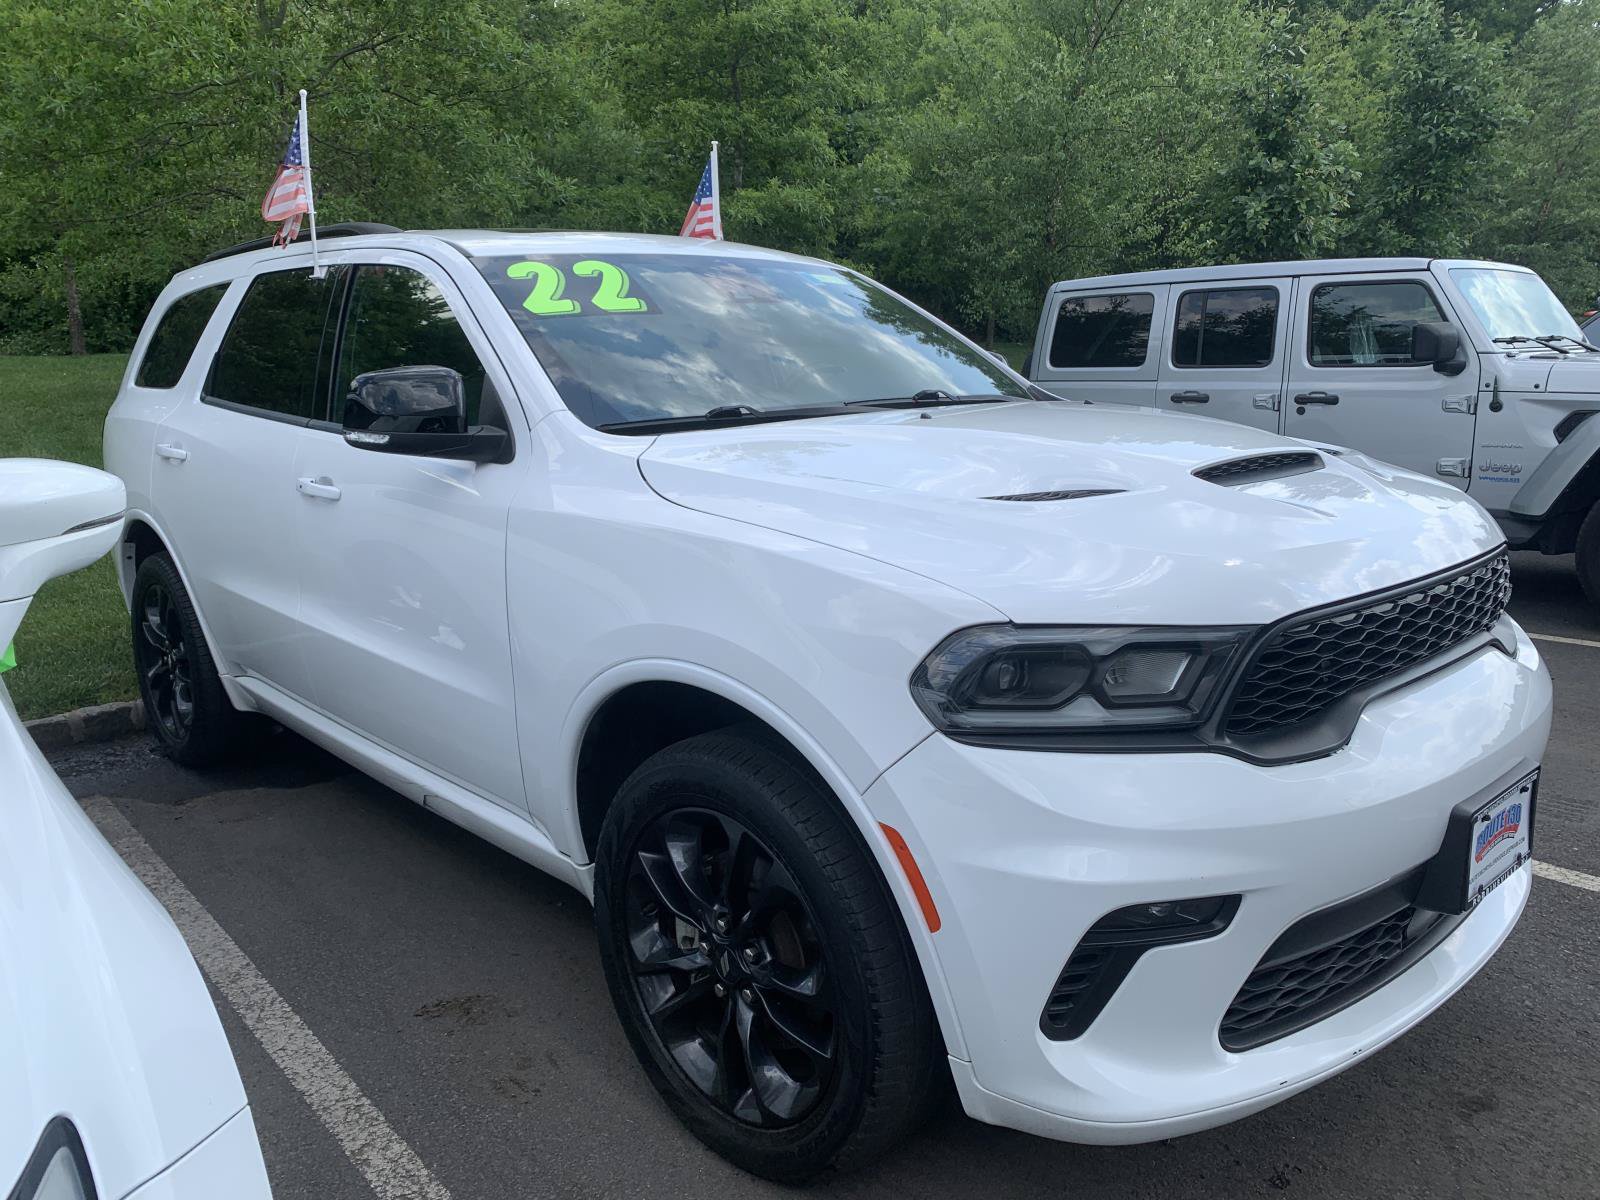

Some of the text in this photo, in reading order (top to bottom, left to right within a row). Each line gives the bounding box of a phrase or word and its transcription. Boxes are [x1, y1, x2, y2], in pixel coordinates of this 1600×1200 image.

[506, 260, 648, 316] 22
[1479, 456, 1523, 475] Jeep
[1476, 809, 1506, 852] ROUTE
[1506, 803, 1522, 824] 130
